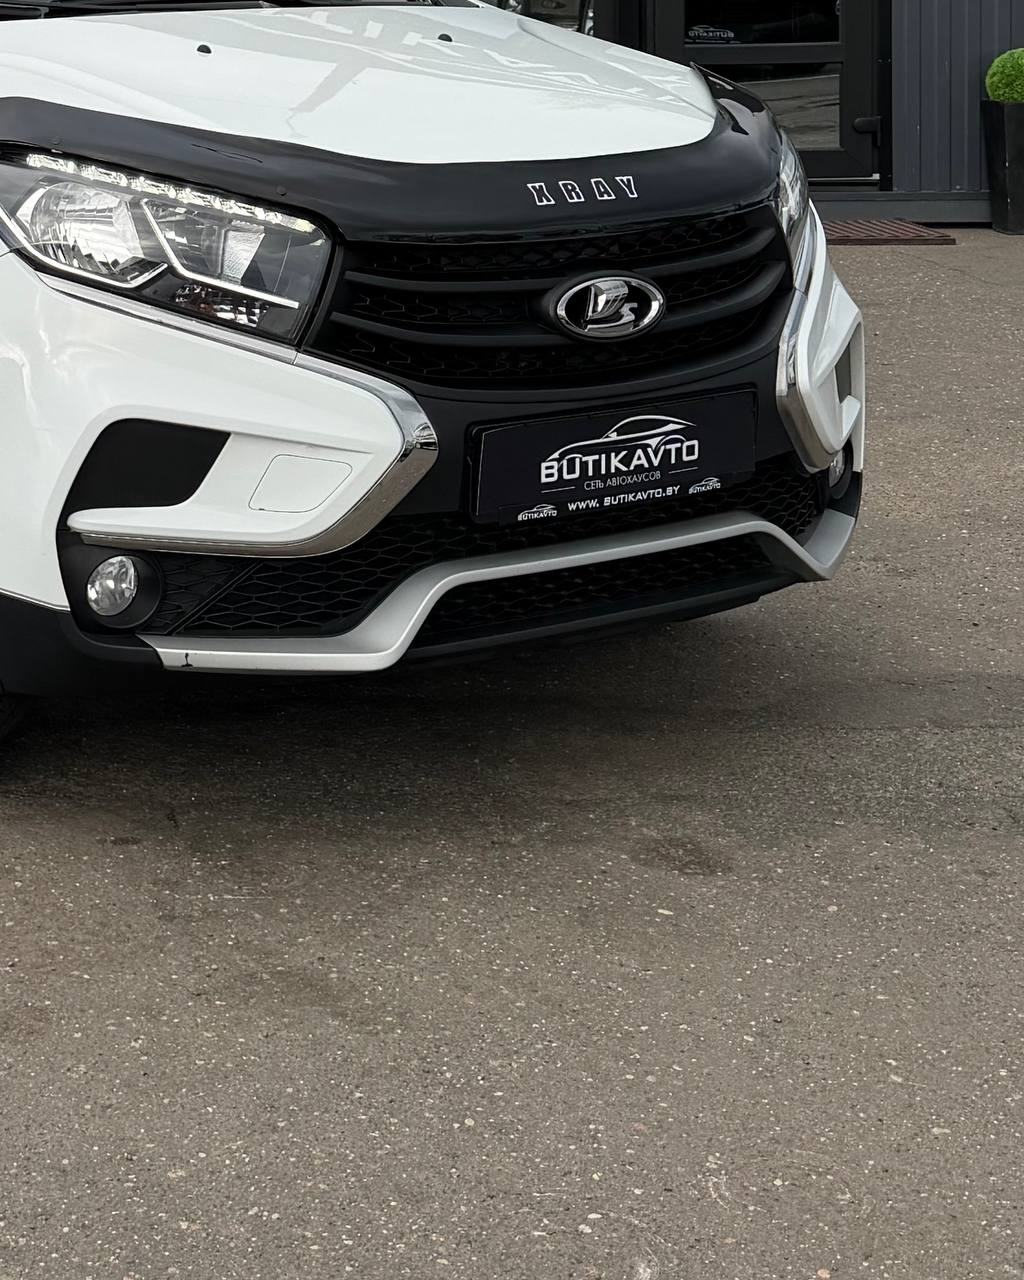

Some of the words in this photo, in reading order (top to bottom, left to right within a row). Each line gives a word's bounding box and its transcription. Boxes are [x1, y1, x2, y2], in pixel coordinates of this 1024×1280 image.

[527, 176, 638, 206] XRAY
[540, 439, 699, 483] BUTIKAVTO
[583, 479, 604, 491] СЕТЬ
[605, 470, 662, 487] АВТОХАУСОВ
